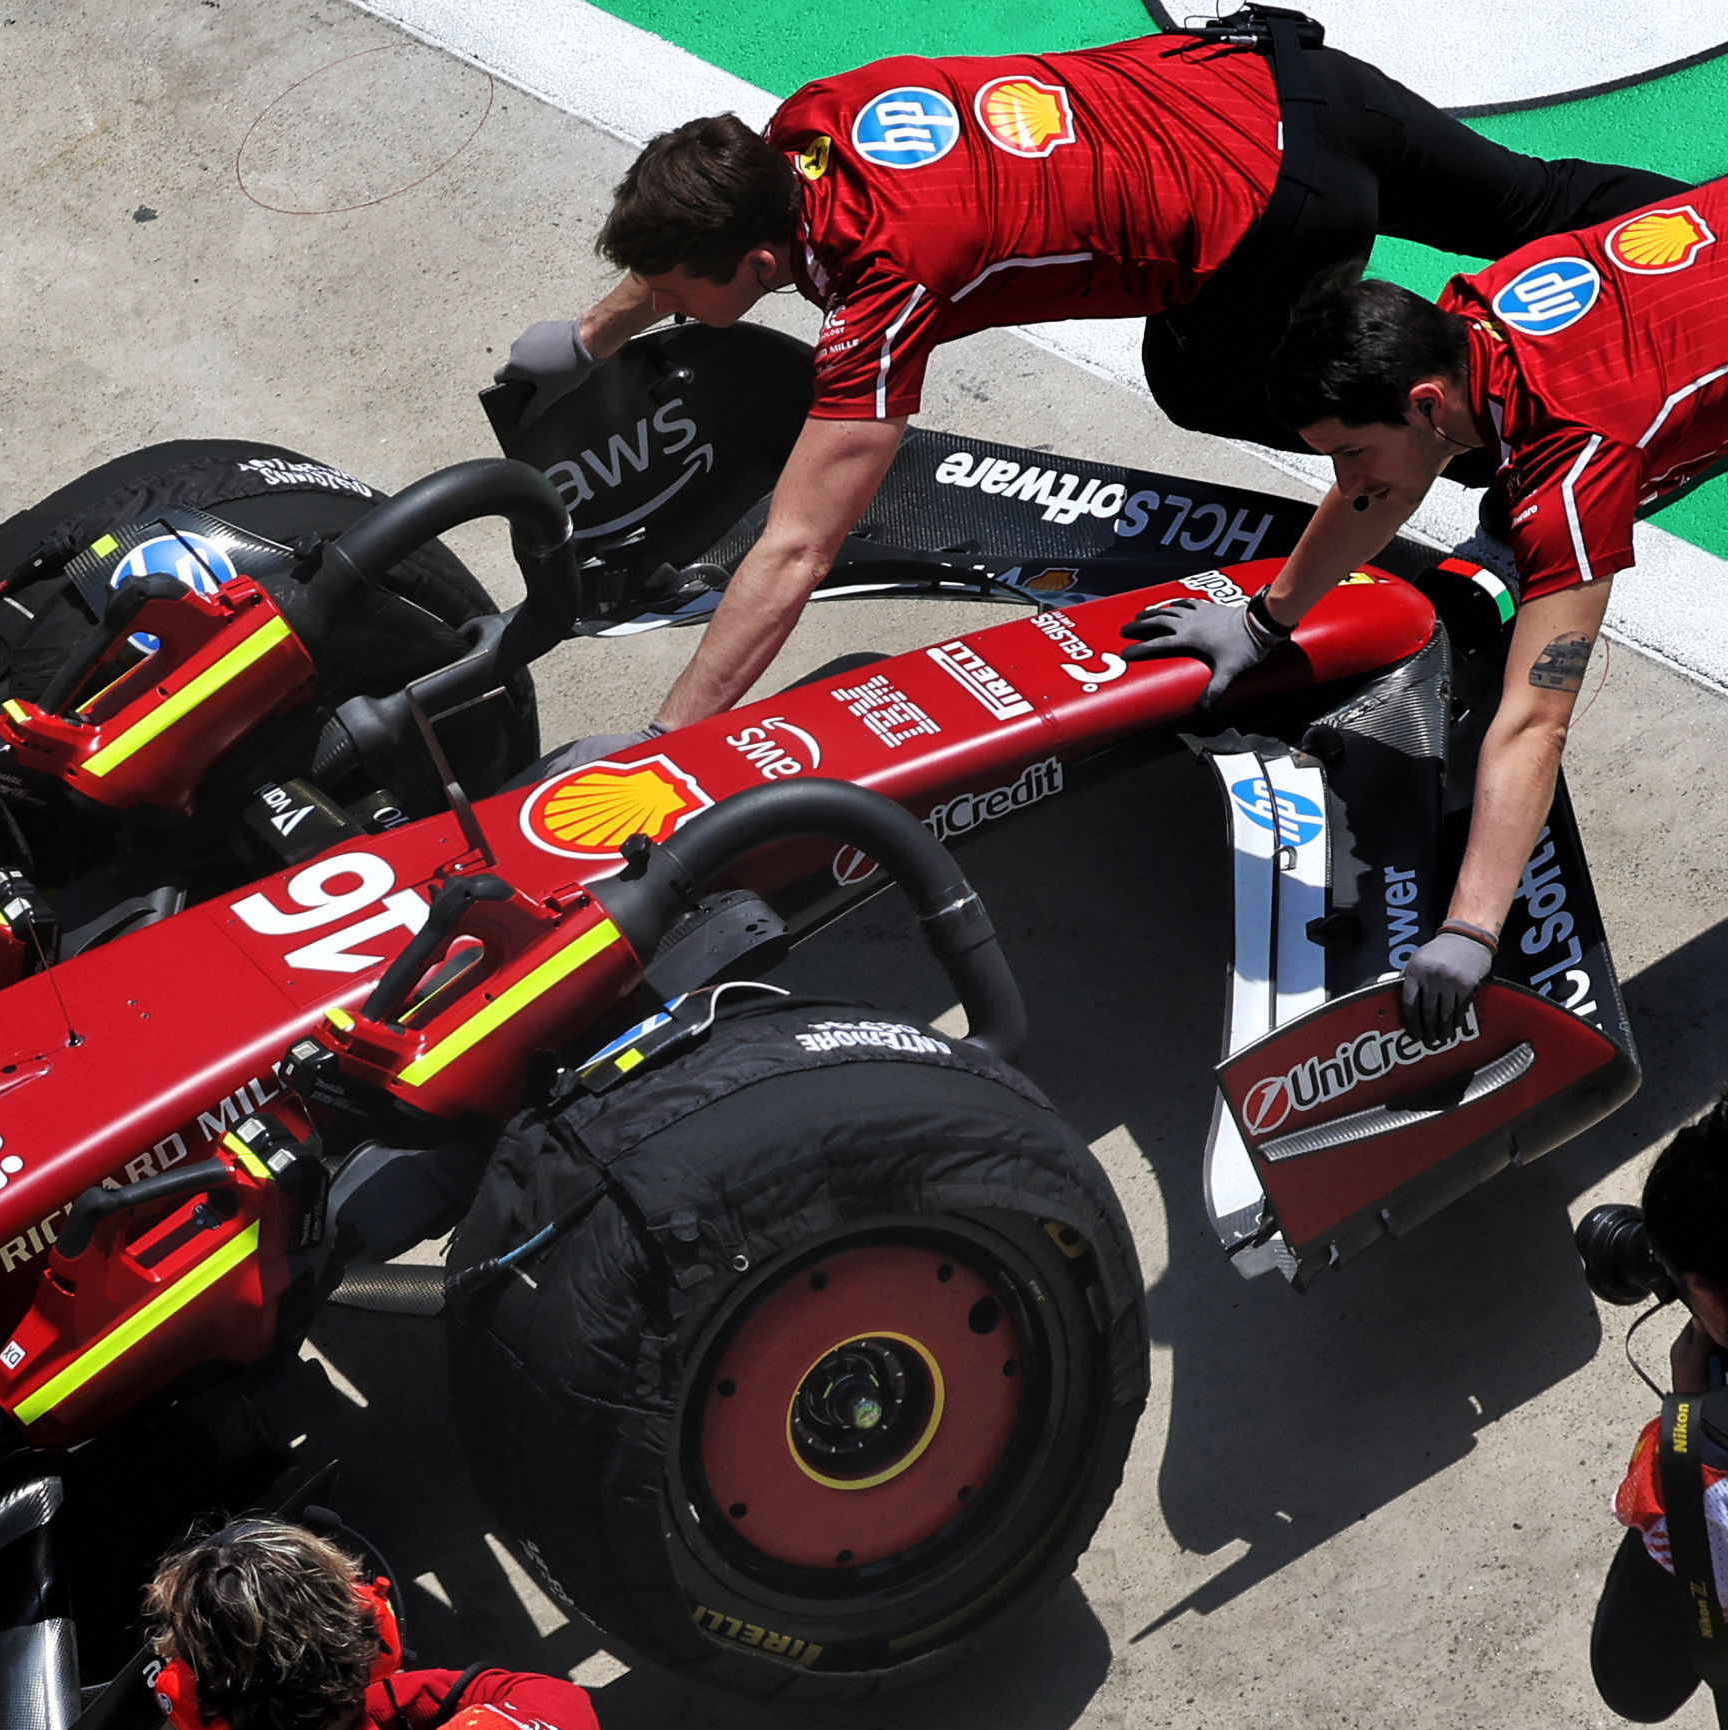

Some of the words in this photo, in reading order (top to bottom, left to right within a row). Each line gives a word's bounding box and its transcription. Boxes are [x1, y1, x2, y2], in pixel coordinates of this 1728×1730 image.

[856, 89, 955, 165] hp
[1496, 259, 1596, 332] hp
[1030, 613, 1093, 661] CELSIUS
[831, 675, 942, 748] IBM
[927, 641, 1033, 721] PIRELLI
[1230, 776, 1324, 847] hp
[1672, 1402, 1690, 1453] Nikon
